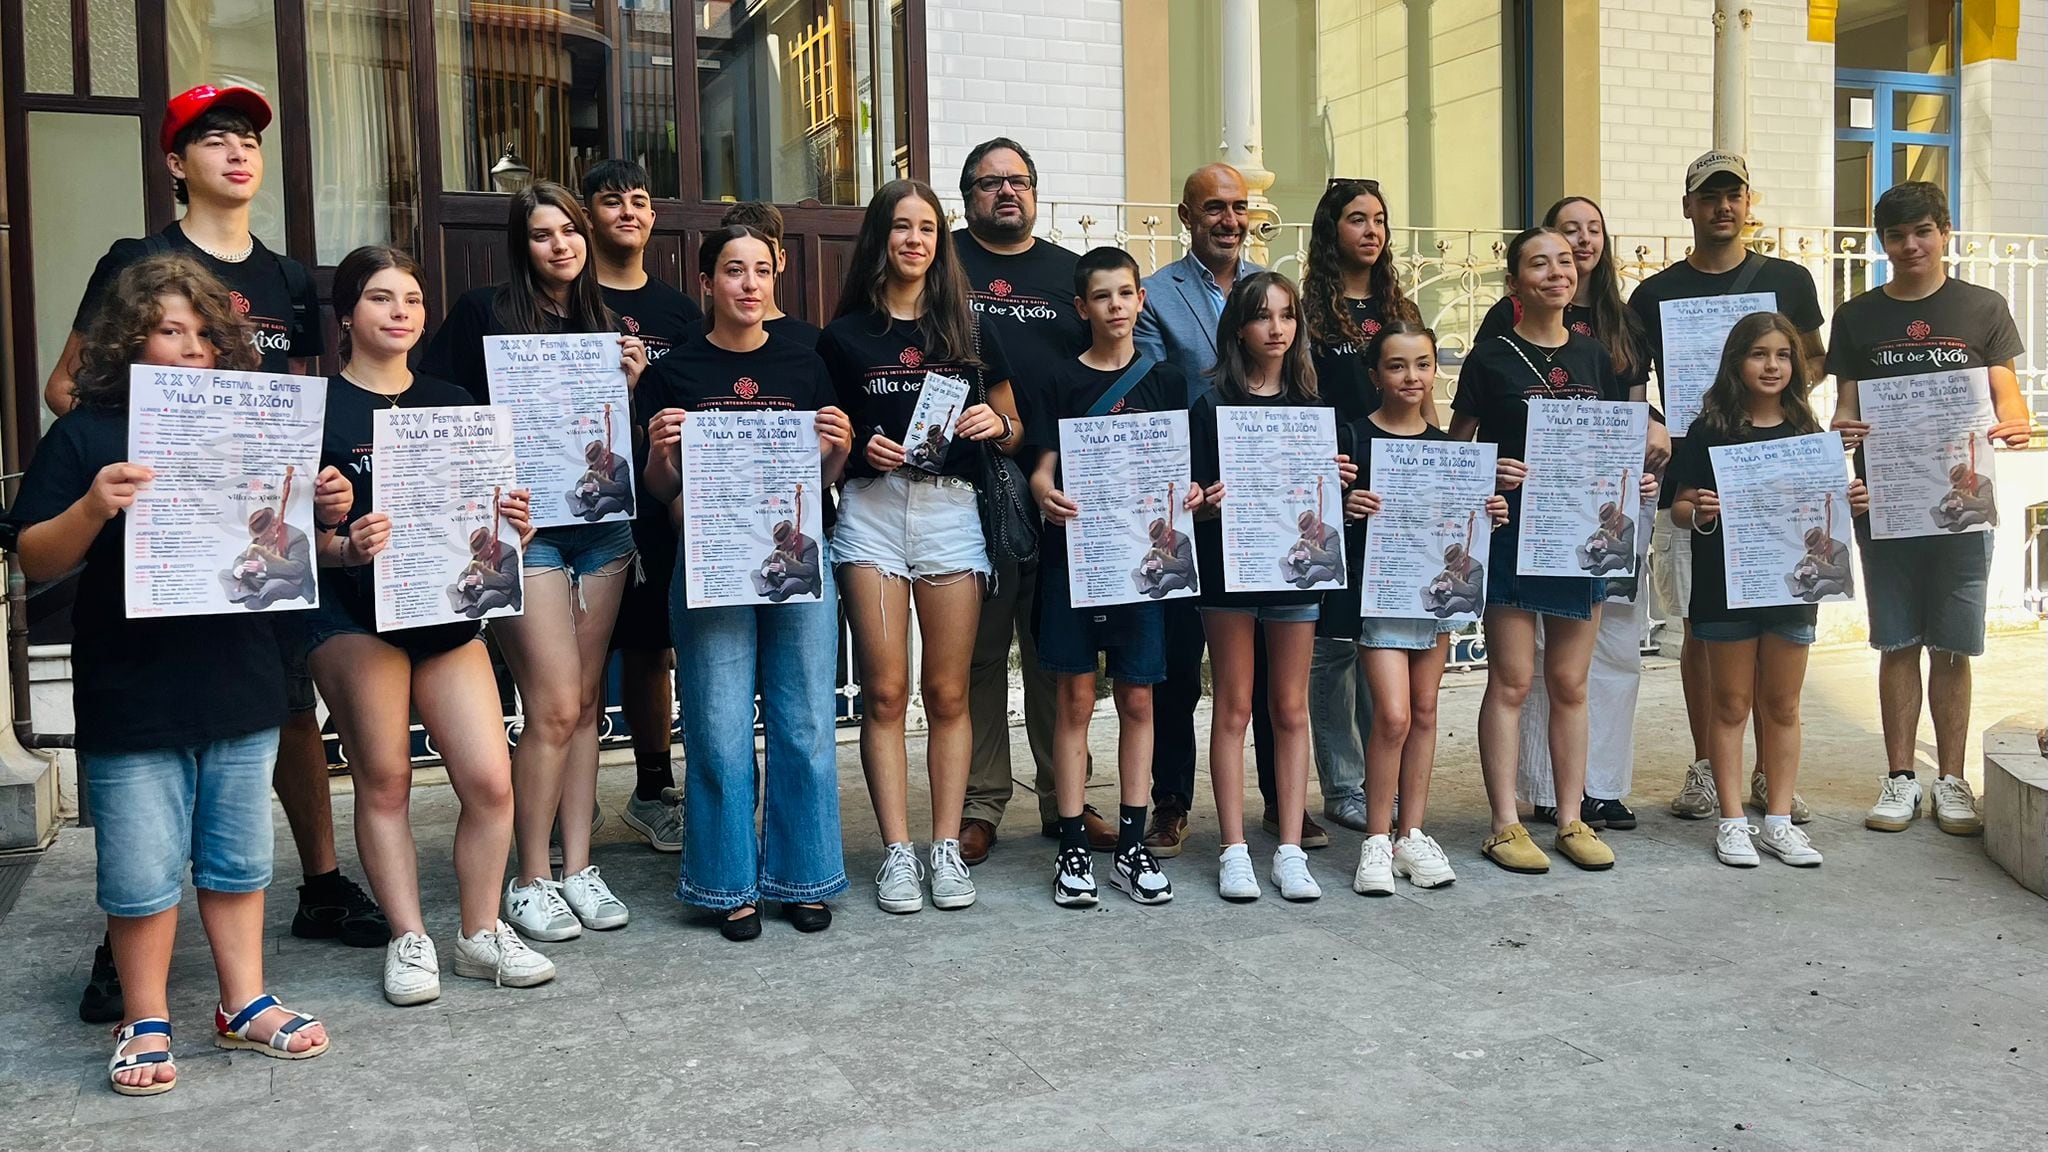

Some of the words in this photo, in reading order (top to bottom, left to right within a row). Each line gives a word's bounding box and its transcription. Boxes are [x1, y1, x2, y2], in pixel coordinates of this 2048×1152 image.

[1009, 305, 1057, 323] Xixón
[508, 352, 539, 362] VILLA
[542, 353, 556, 361] DE
[1870, 350, 1904, 366] Villa
[1907, 352, 1925, 361] de
[1926, 348, 1968, 367] Xixón
[154, 372, 201, 387] XXV
[212, 376, 254, 390] FESTIVAL
[269, 380, 302, 393] GAITES
[862, 378, 899, 395] Villa
[902, 380, 921, 392] de
[163, 389, 206, 405] VILLA
[213, 395, 233, 405] DE
[239, 393, 294, 409] XIXÓN
[1878, 392, 1908, 401] VILLA
[389, 413, 424, 426] XXV
[696, 416, 729, 427] XXV
[1546, 415, 1573, 425] VILLA
[1236, 423, 1263, 432] VILLA
[396, 428, 429, 439] VILLA
[434, 429, 448, 438] DE
[702, 429, 734, 439] VILLA
[738, 430, 752, 438] DE
[1080, 434, 1110, 444] VILLA
[1114, 434, 1126, 442] DE
[1391, 455, 1418, 465] VILLA
